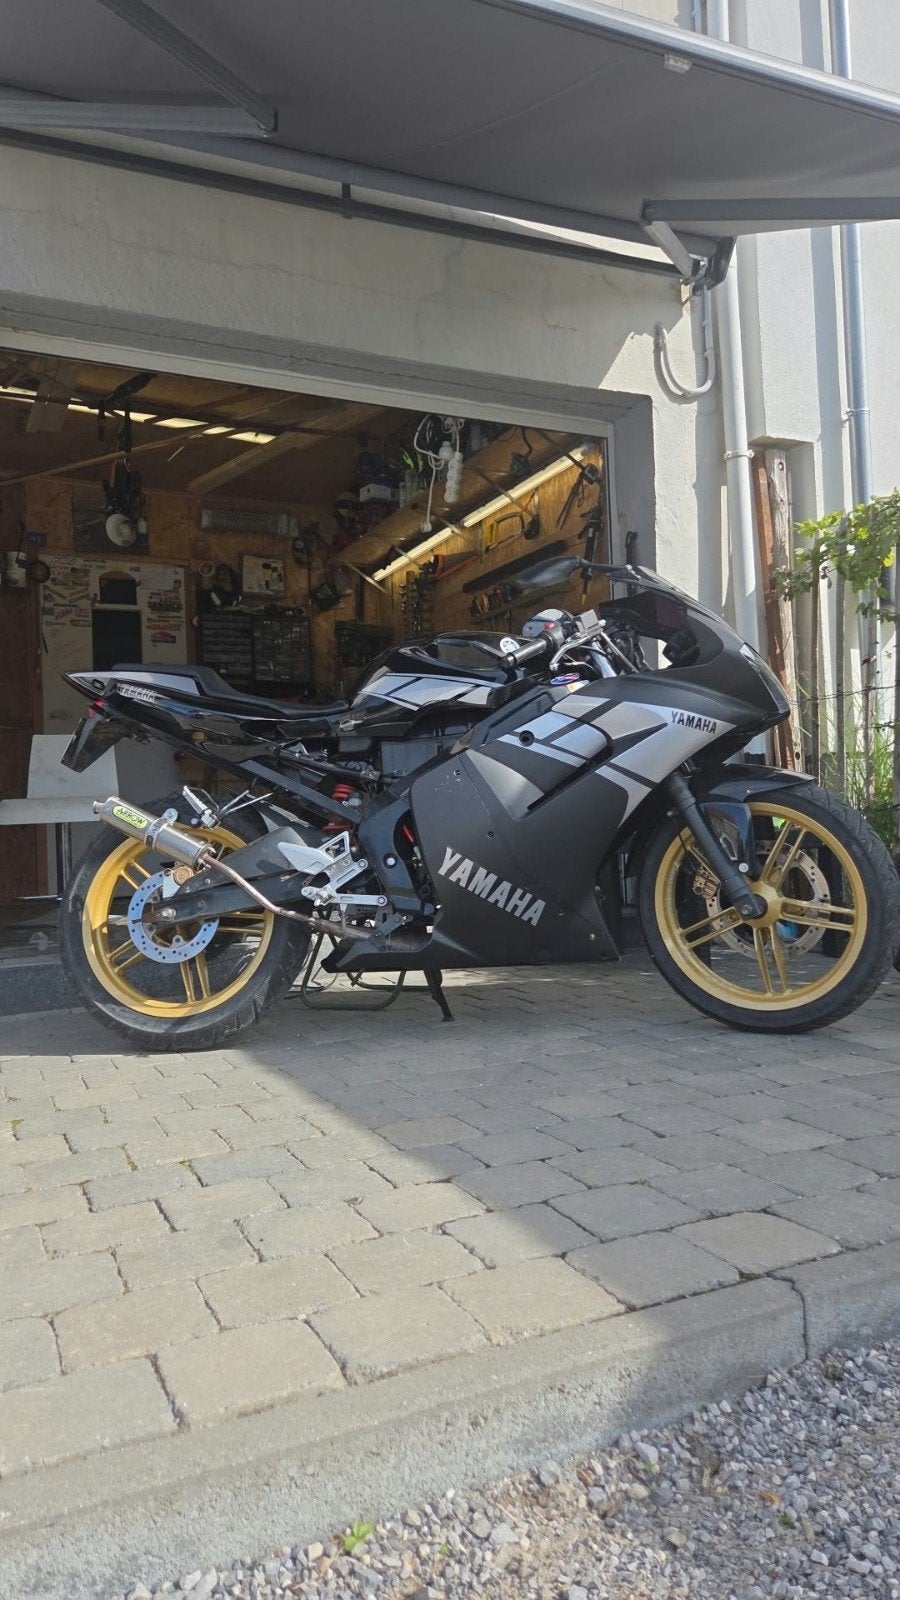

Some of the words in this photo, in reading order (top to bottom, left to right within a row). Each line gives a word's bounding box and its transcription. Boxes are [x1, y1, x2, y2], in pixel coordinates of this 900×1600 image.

[671, 710, 717, 734] YAMAHA
[117, 807, 146, 825] ARROW
[438, 846, 546, 927] YAMAHA
